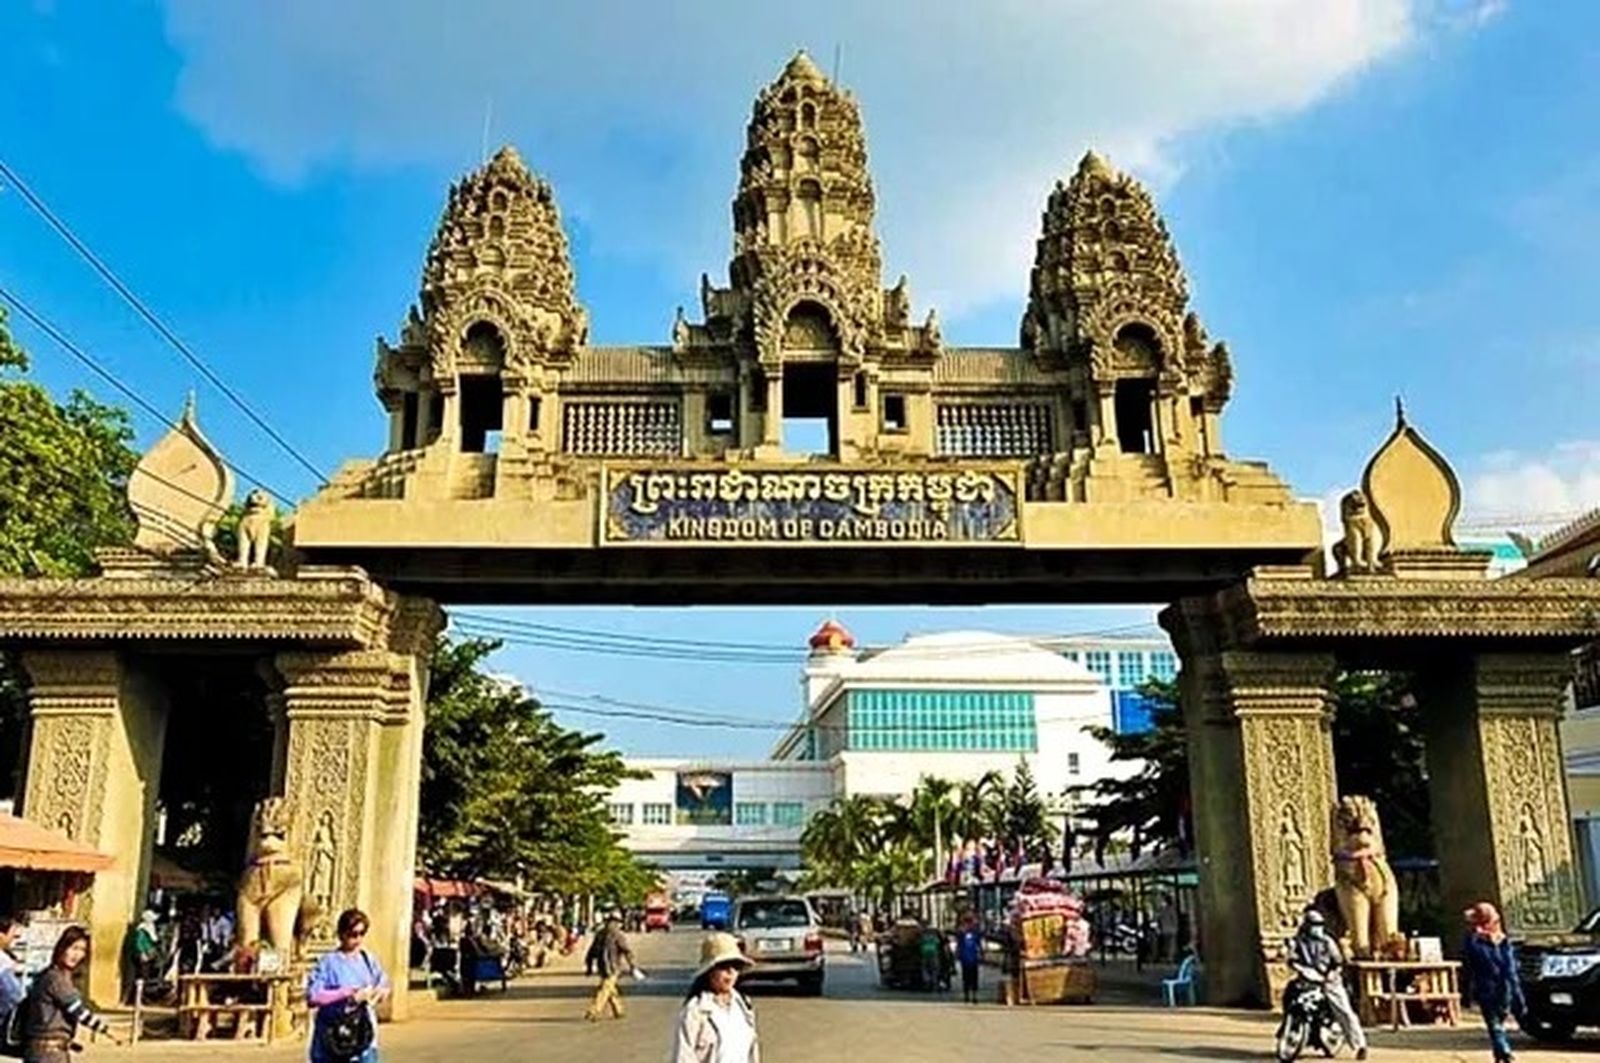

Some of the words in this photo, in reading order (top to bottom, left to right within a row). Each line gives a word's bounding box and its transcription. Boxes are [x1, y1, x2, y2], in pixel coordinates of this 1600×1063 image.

[668, 517, 778, 538] KINGDOM
[783, 518, 813, 539] OF
[819, 519, 948, 539] CAMBODIA
